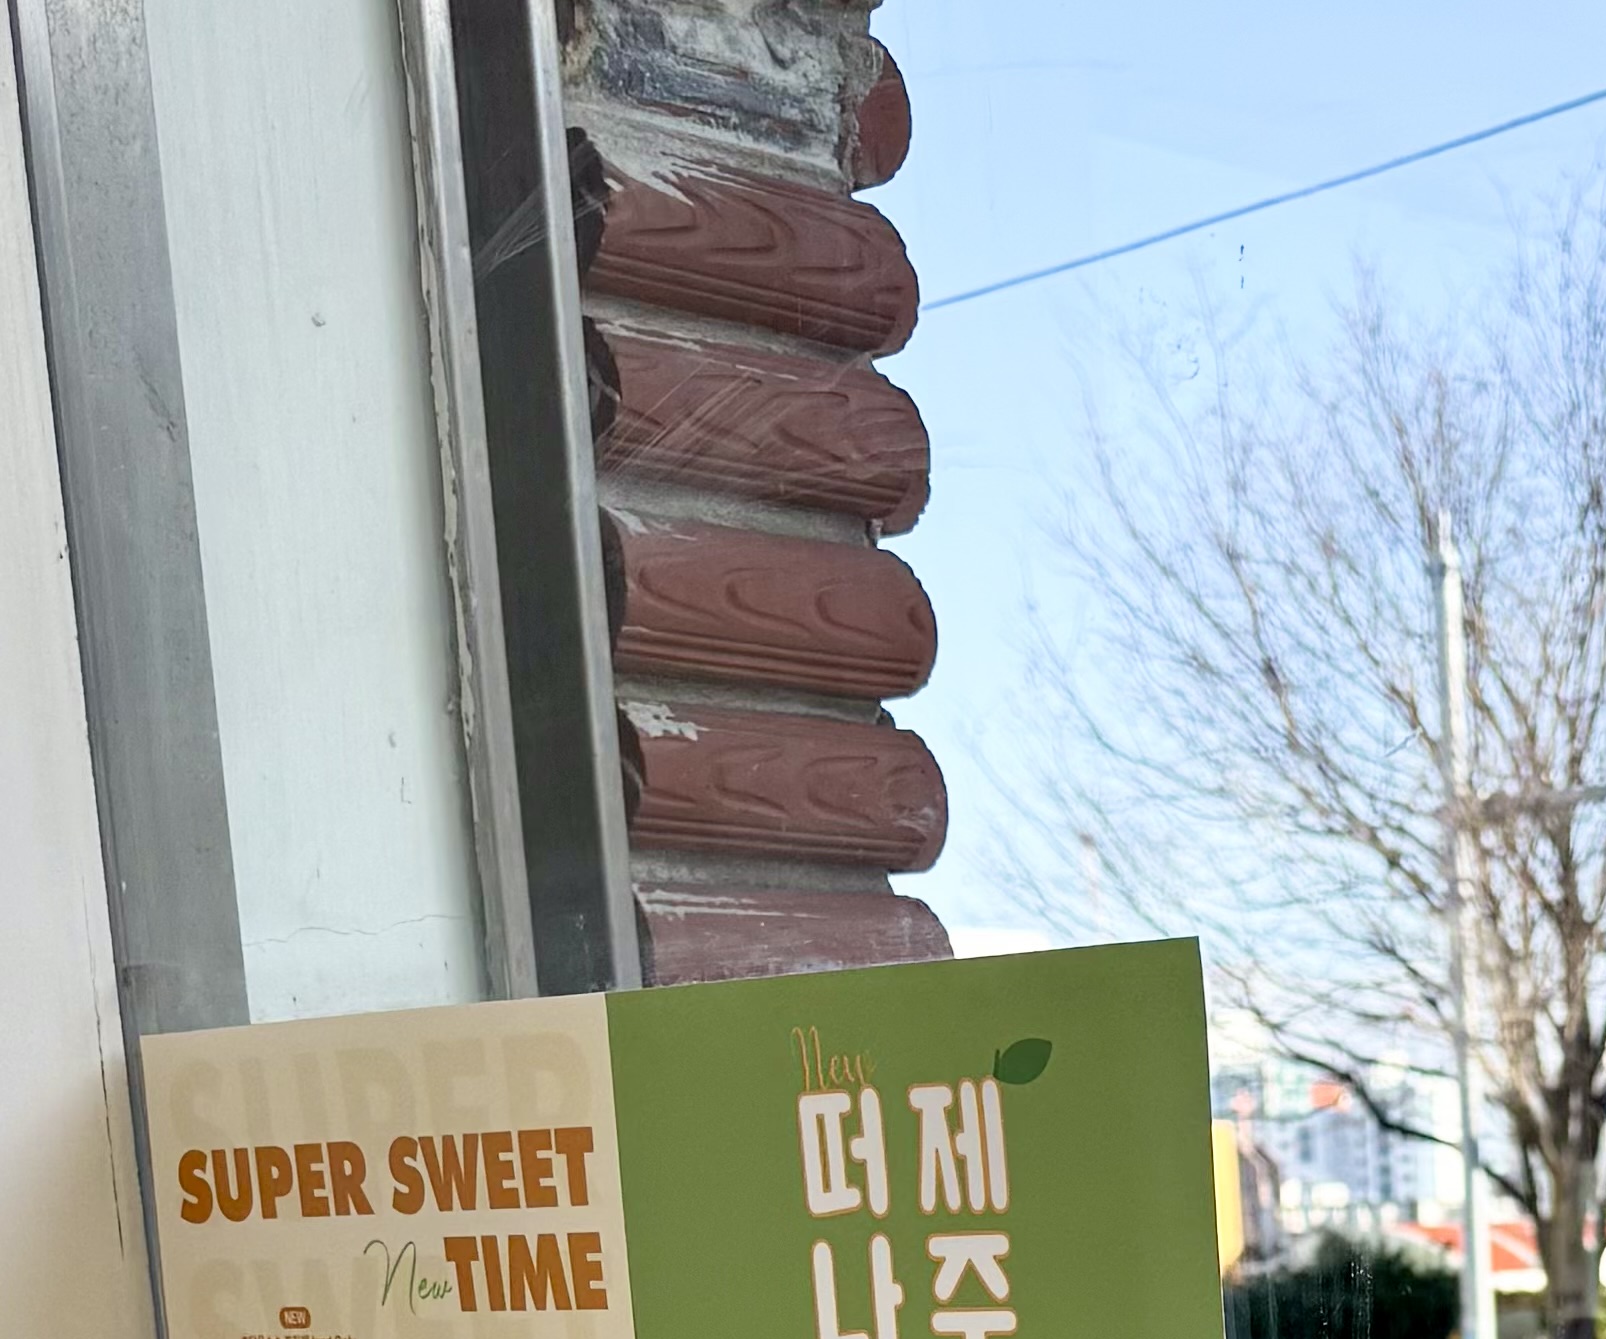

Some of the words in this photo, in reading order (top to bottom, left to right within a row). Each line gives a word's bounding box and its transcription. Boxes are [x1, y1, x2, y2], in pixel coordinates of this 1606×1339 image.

[177, 1140, 376, 1225] SUPER
[388, 1125, 595, 1216] SWEET
[363, 1239, 453, 1316] New
[443, 1231, 610, 1313] TIME
